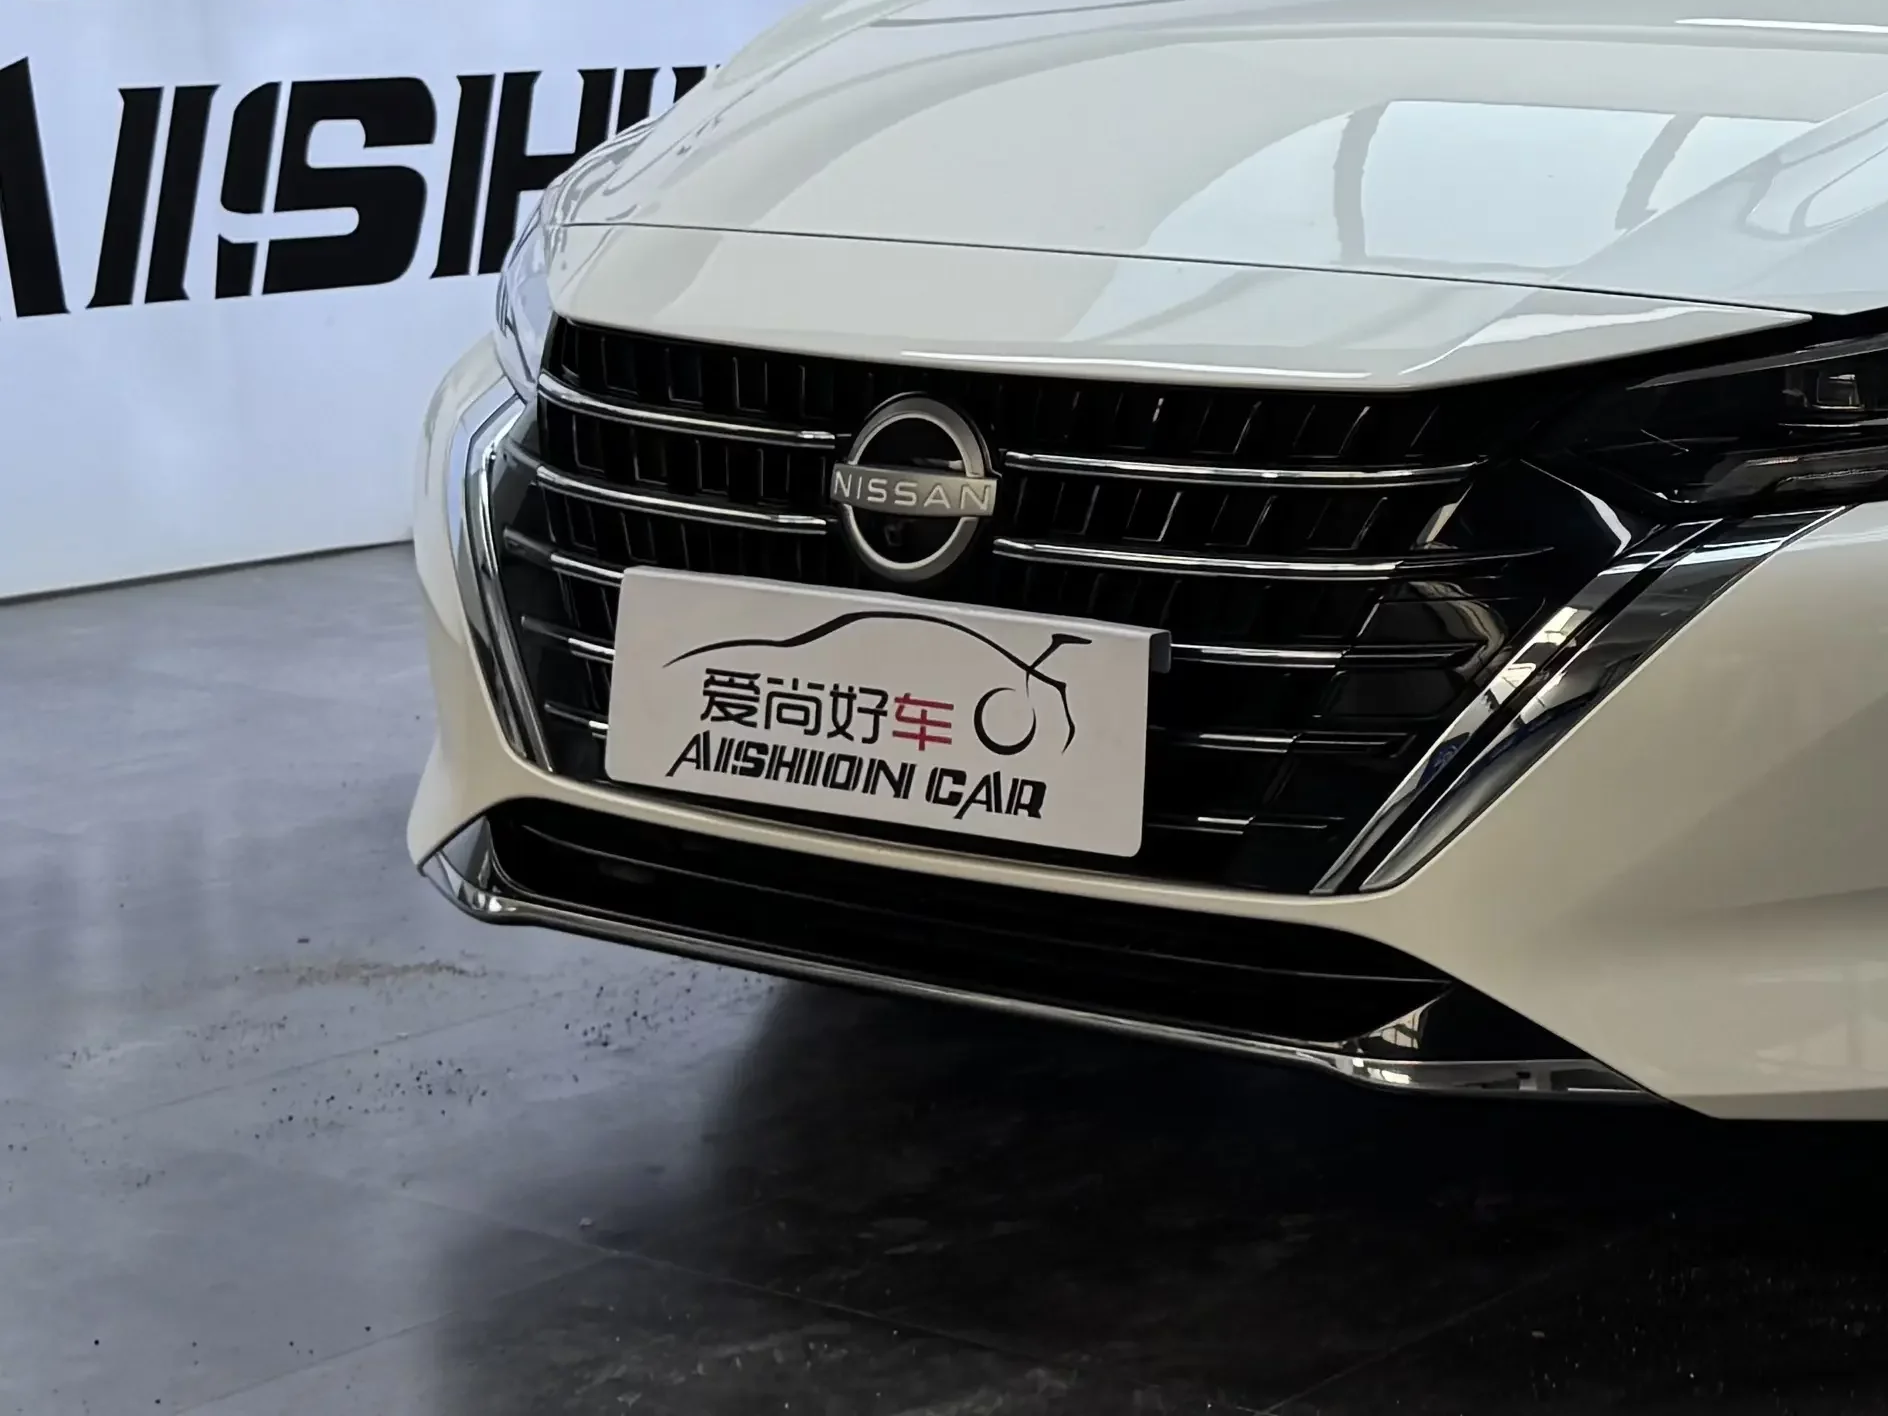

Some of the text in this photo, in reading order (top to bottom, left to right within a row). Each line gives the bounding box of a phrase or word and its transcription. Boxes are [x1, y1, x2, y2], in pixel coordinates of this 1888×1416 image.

[0, 56, 722, 318] AISH
[833, 470, 992, 510] NISSAN
[700, 667, 955, 752] 爱尚好车
[665, 729, 1048, 820] AISHION CAR
